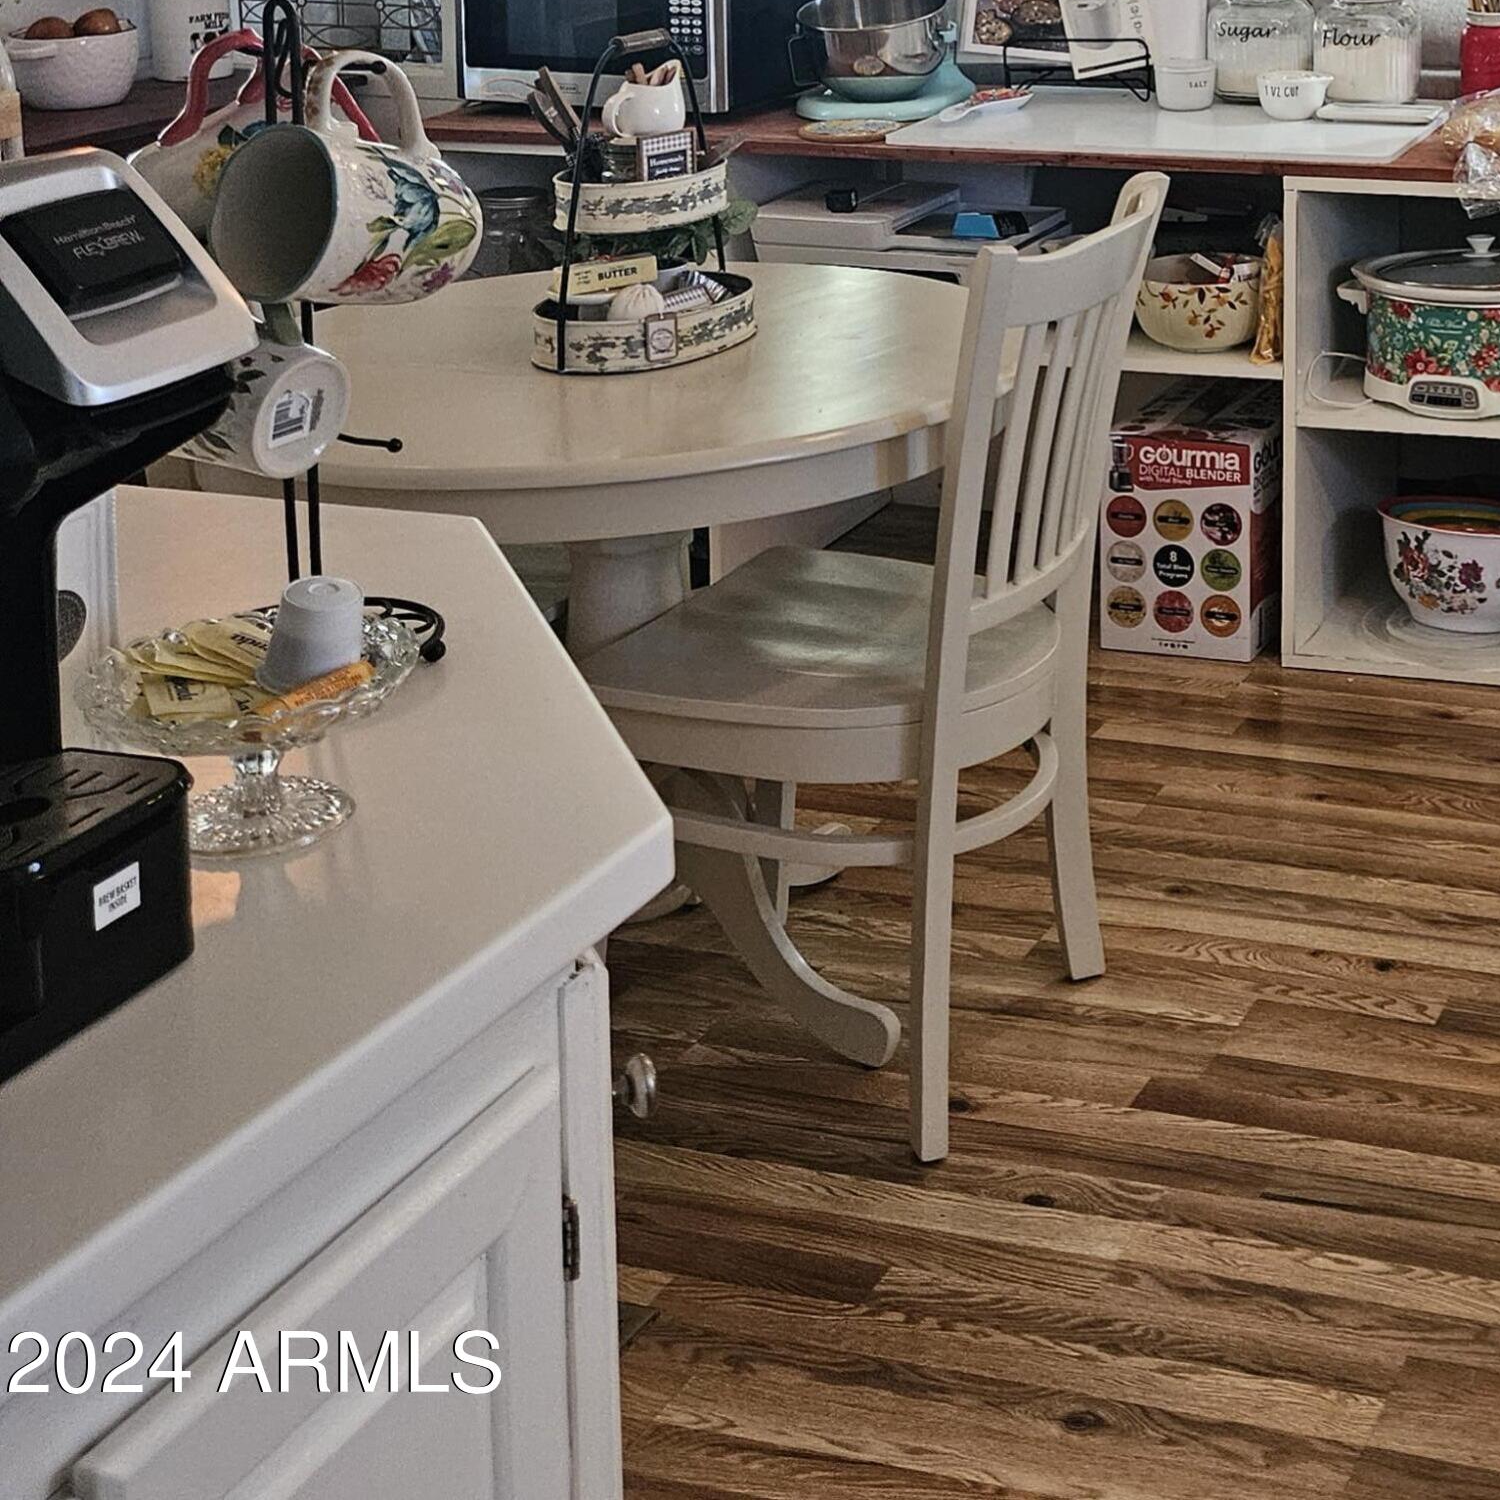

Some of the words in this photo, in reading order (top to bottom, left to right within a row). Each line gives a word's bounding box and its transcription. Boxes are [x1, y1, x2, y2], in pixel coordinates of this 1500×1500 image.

[1217, 22, 1276, 43] Sugar
[1322, 28, 1381, 48] Flour
[1189, 81, 1208, 89] SALT
[597, 266, 638, 281] BUTTER
[1139, 463, 1183, 478] DIGITAL
[1185, 468, 1242, 483] BLENDER
[1169, 551, 1178, 562] 8
[1173, 563, 1191, 571] Blend
